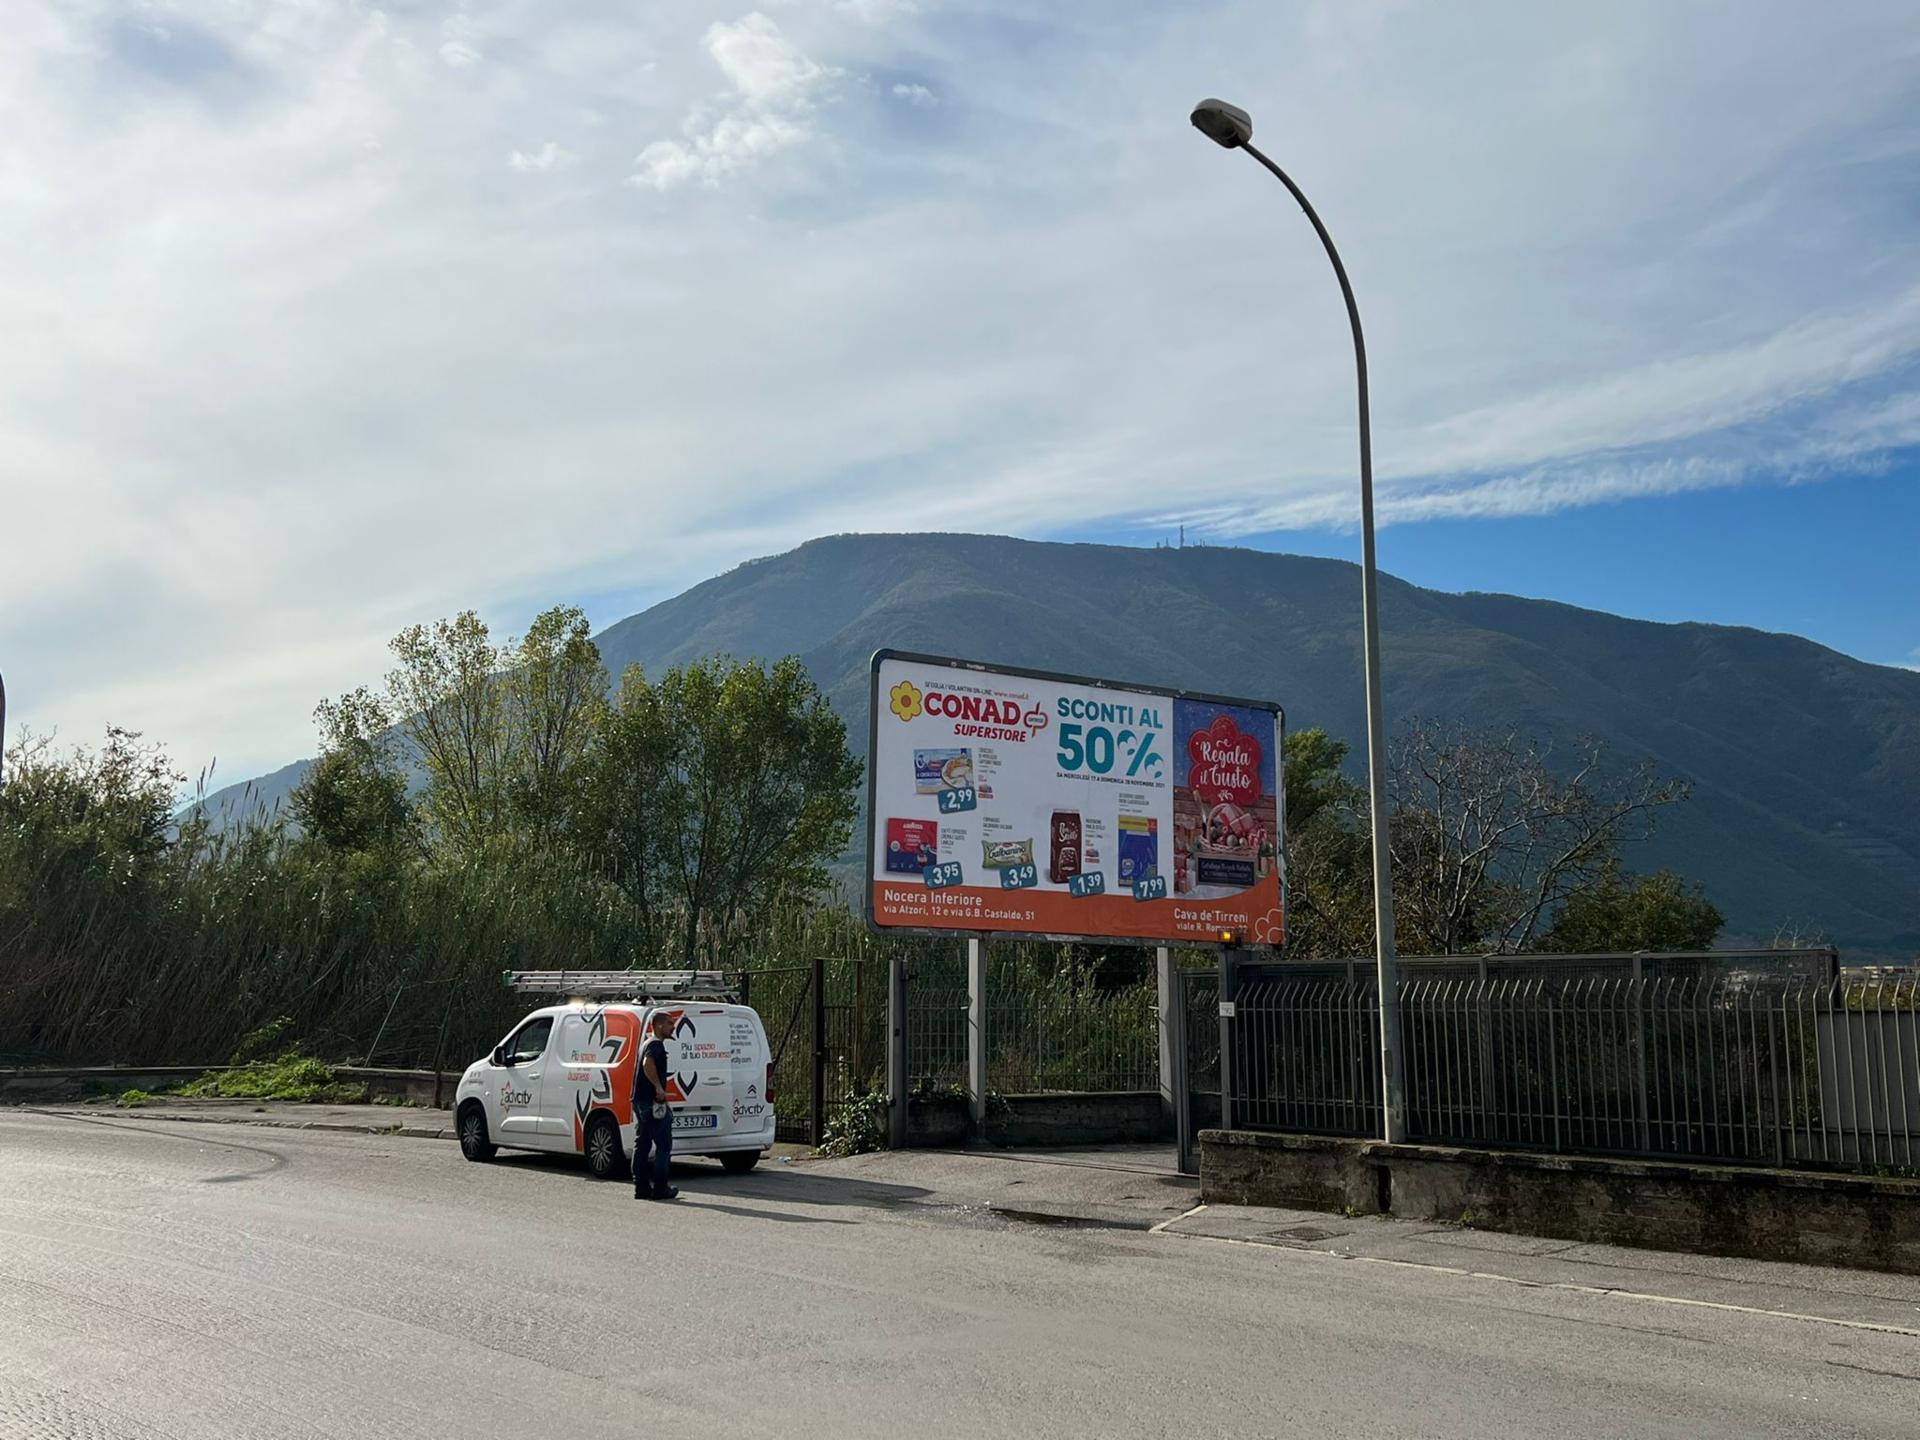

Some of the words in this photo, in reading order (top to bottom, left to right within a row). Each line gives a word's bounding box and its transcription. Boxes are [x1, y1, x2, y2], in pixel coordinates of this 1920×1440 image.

[924, 692, 1021, 724] CONAD
[1057, 697, 1133, 725] SCONTI
[1139, 708, 1164, 728] AL
[954, 723, 1027, 742] SUPERSTORE
[1057, 723, 1164, 778] 50%
[1200, 741, 1250, 768] Regala
[1200, 770, 1208, 784] il
[1209, 764, 1251, 789] Gusto
[947, 789, 972, 809] 2,99
[932, 864, 959, 885] 3,95
[1009, 867, 1034, 886] 3,49
[1077, 874, 1101, 893] 1,39
[884, 889, 927, 903] Nocera
[931, 892, 982, 906] Inferiore
[1140, 879, 1163, 897] 7,99
[884, 906, 897, 914] via
[932, 907, 940, 915] 12
[950, 908, 963, 916] via
[1025, 911, 1035, 920] 51
[1174, 907, 1197, 920] Cava
[1215, 910, 1248, 923] Tirreni
[1177, 921, 1195, 931] viale
[702, 1051, 730, 1059] business
[504, 1089, 532, 1104] advcity
[733, 1104, 764, 1115] advcity
